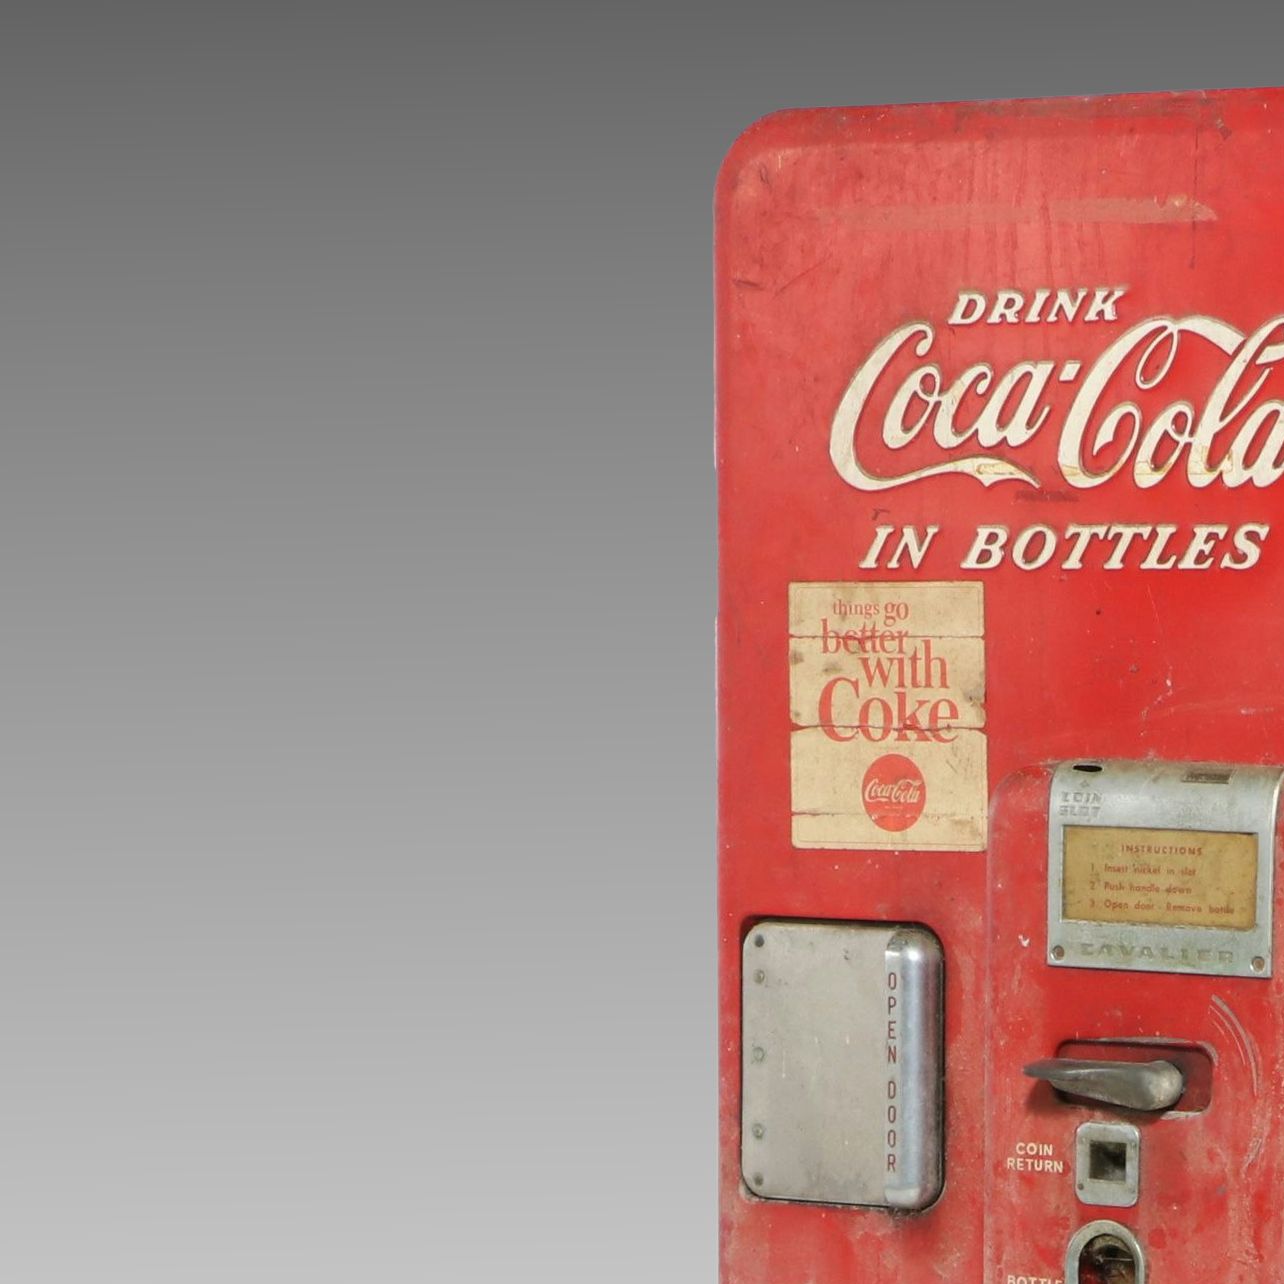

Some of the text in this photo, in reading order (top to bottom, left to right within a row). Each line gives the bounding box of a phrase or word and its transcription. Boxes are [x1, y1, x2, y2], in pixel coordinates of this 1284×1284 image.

[948, 288, 1128, 325] DRINK
[859, 524, 1270, 571] IN BOTTLES
[832, 599, 909, 627] things go
[820, 618, 909, 654] better
[858, 640, 950, 689] with
[818, 676, 959, 743] Coke
[864, 778, 921, 803] Coca-Cola
[1120, 845, 1203, 856] INSTRUCTIONS
[1103, 863, 1128, 873] Insert
[1103, 881, 1126, 892] Push
[1129, 882, 1160, 893] handle
[1164, 883, 1193, 894] down
[1103, 899, 1129, 912] Open
[1165, 900, 1203, 912] Remove
[886, 971, 898, 1174] OPEN DOOR
[1015, 1142, 1054, 1156] COIN
[1006, 1157, 1065, 1174] RETURN
